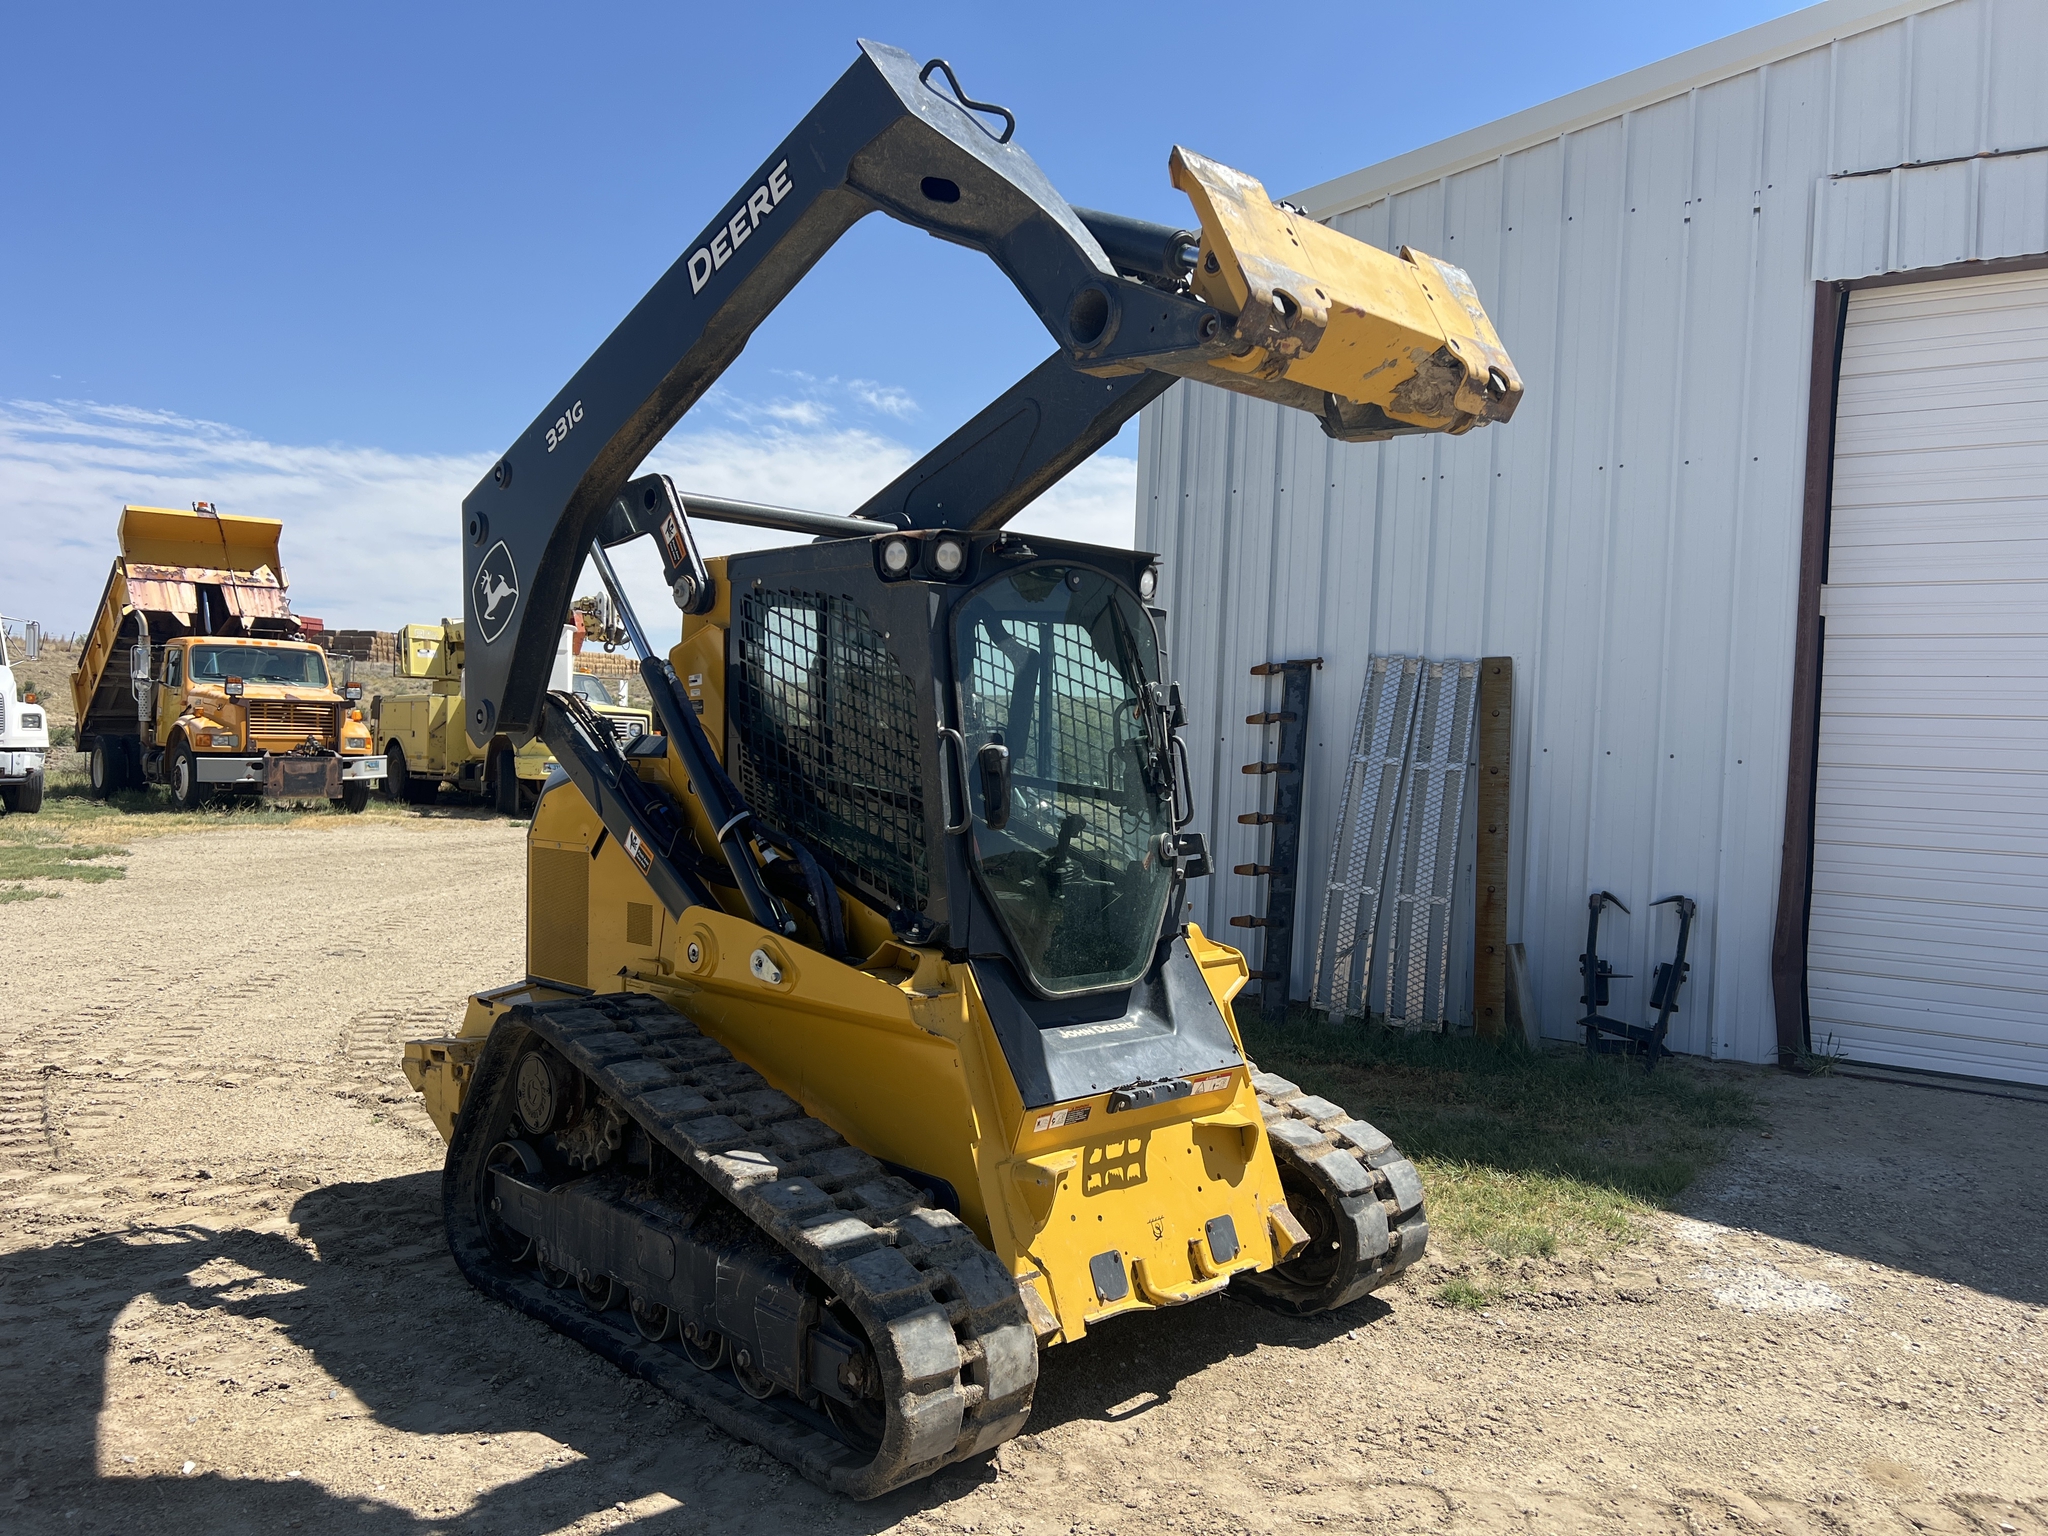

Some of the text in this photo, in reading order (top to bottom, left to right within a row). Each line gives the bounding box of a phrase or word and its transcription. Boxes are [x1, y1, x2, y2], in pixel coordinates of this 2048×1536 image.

[687, 159, 793, 295] DEERE
[545, 400, 584, 453] 331G
[1058, 1021, 1140, 1039] JOHN DEERE
